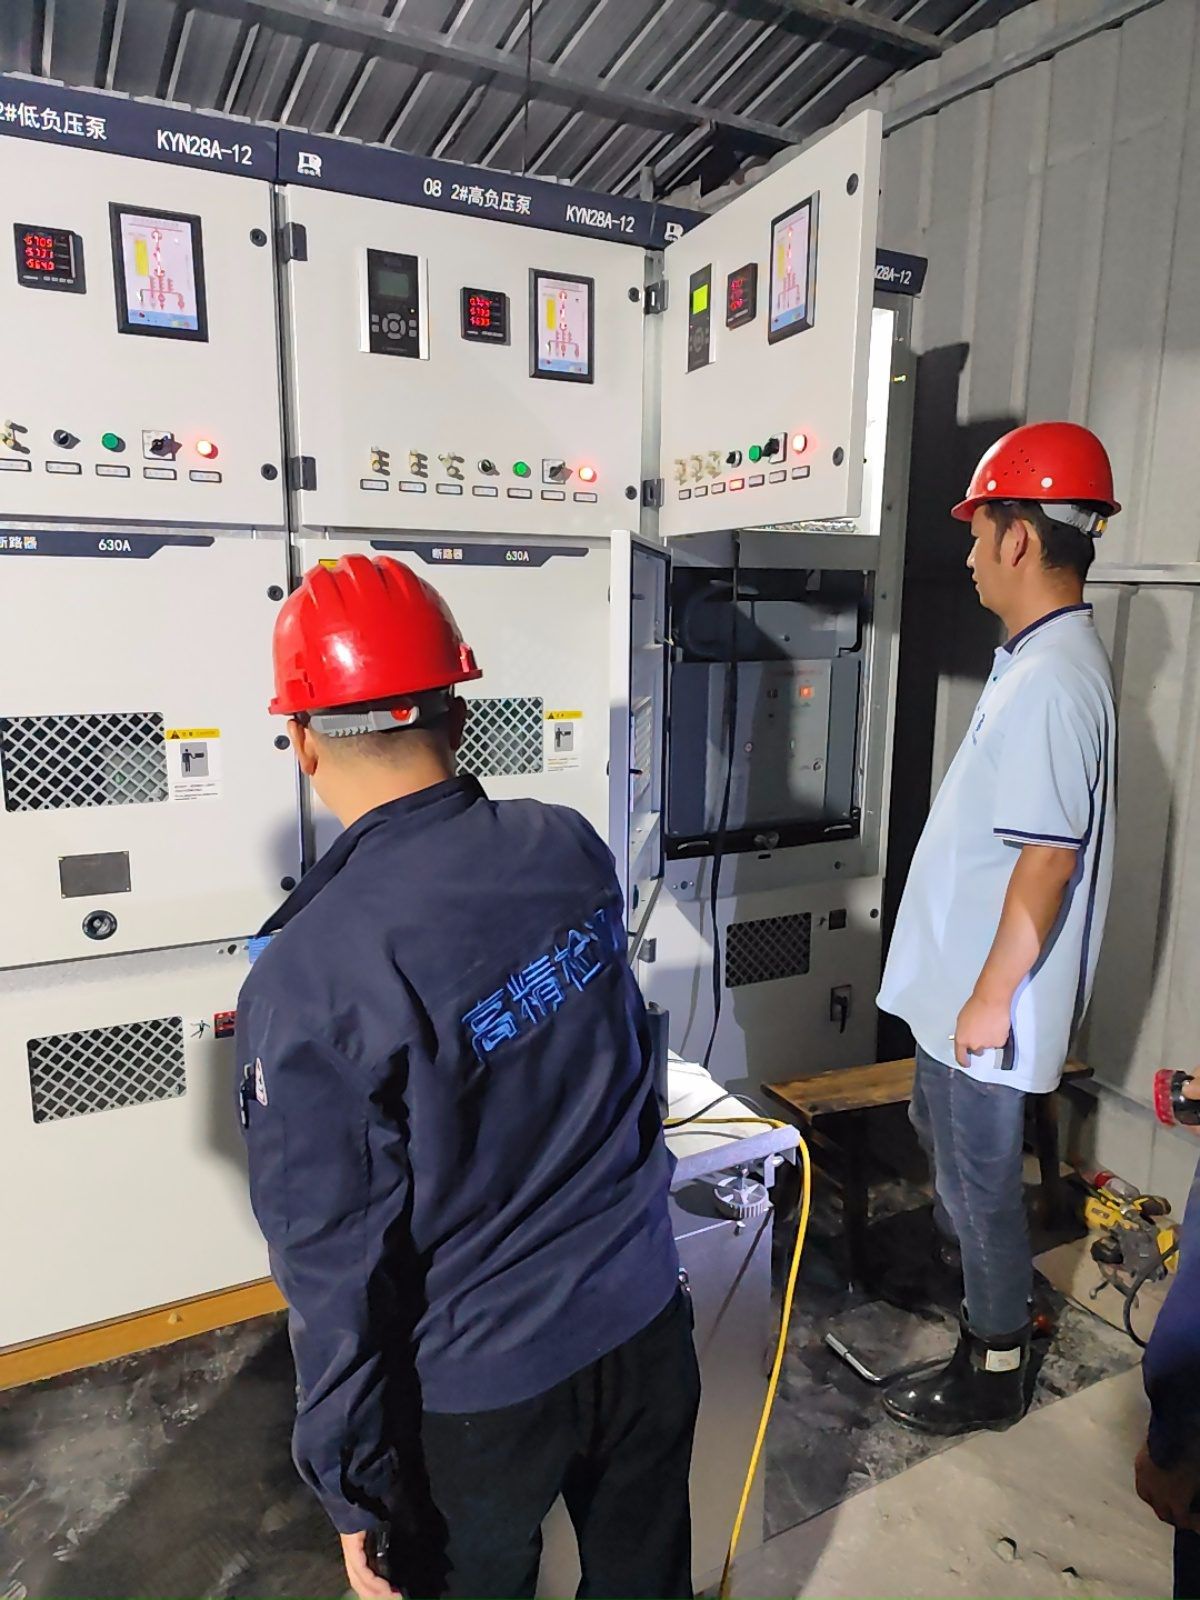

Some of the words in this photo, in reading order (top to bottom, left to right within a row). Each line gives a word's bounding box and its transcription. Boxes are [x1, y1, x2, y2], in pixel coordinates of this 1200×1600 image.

[157, 129, 253, 165] KYN28A-12
[423, 178, 442, 197] 08
[450, 184, 532, 215] 2#高负压泵
[566, 204, 635, 233] KYN28A-12
[98, 538, 132, 551] 630A
[505, 550, 530, 561] 630A
[460, 908, 607, 1066] 高精检
